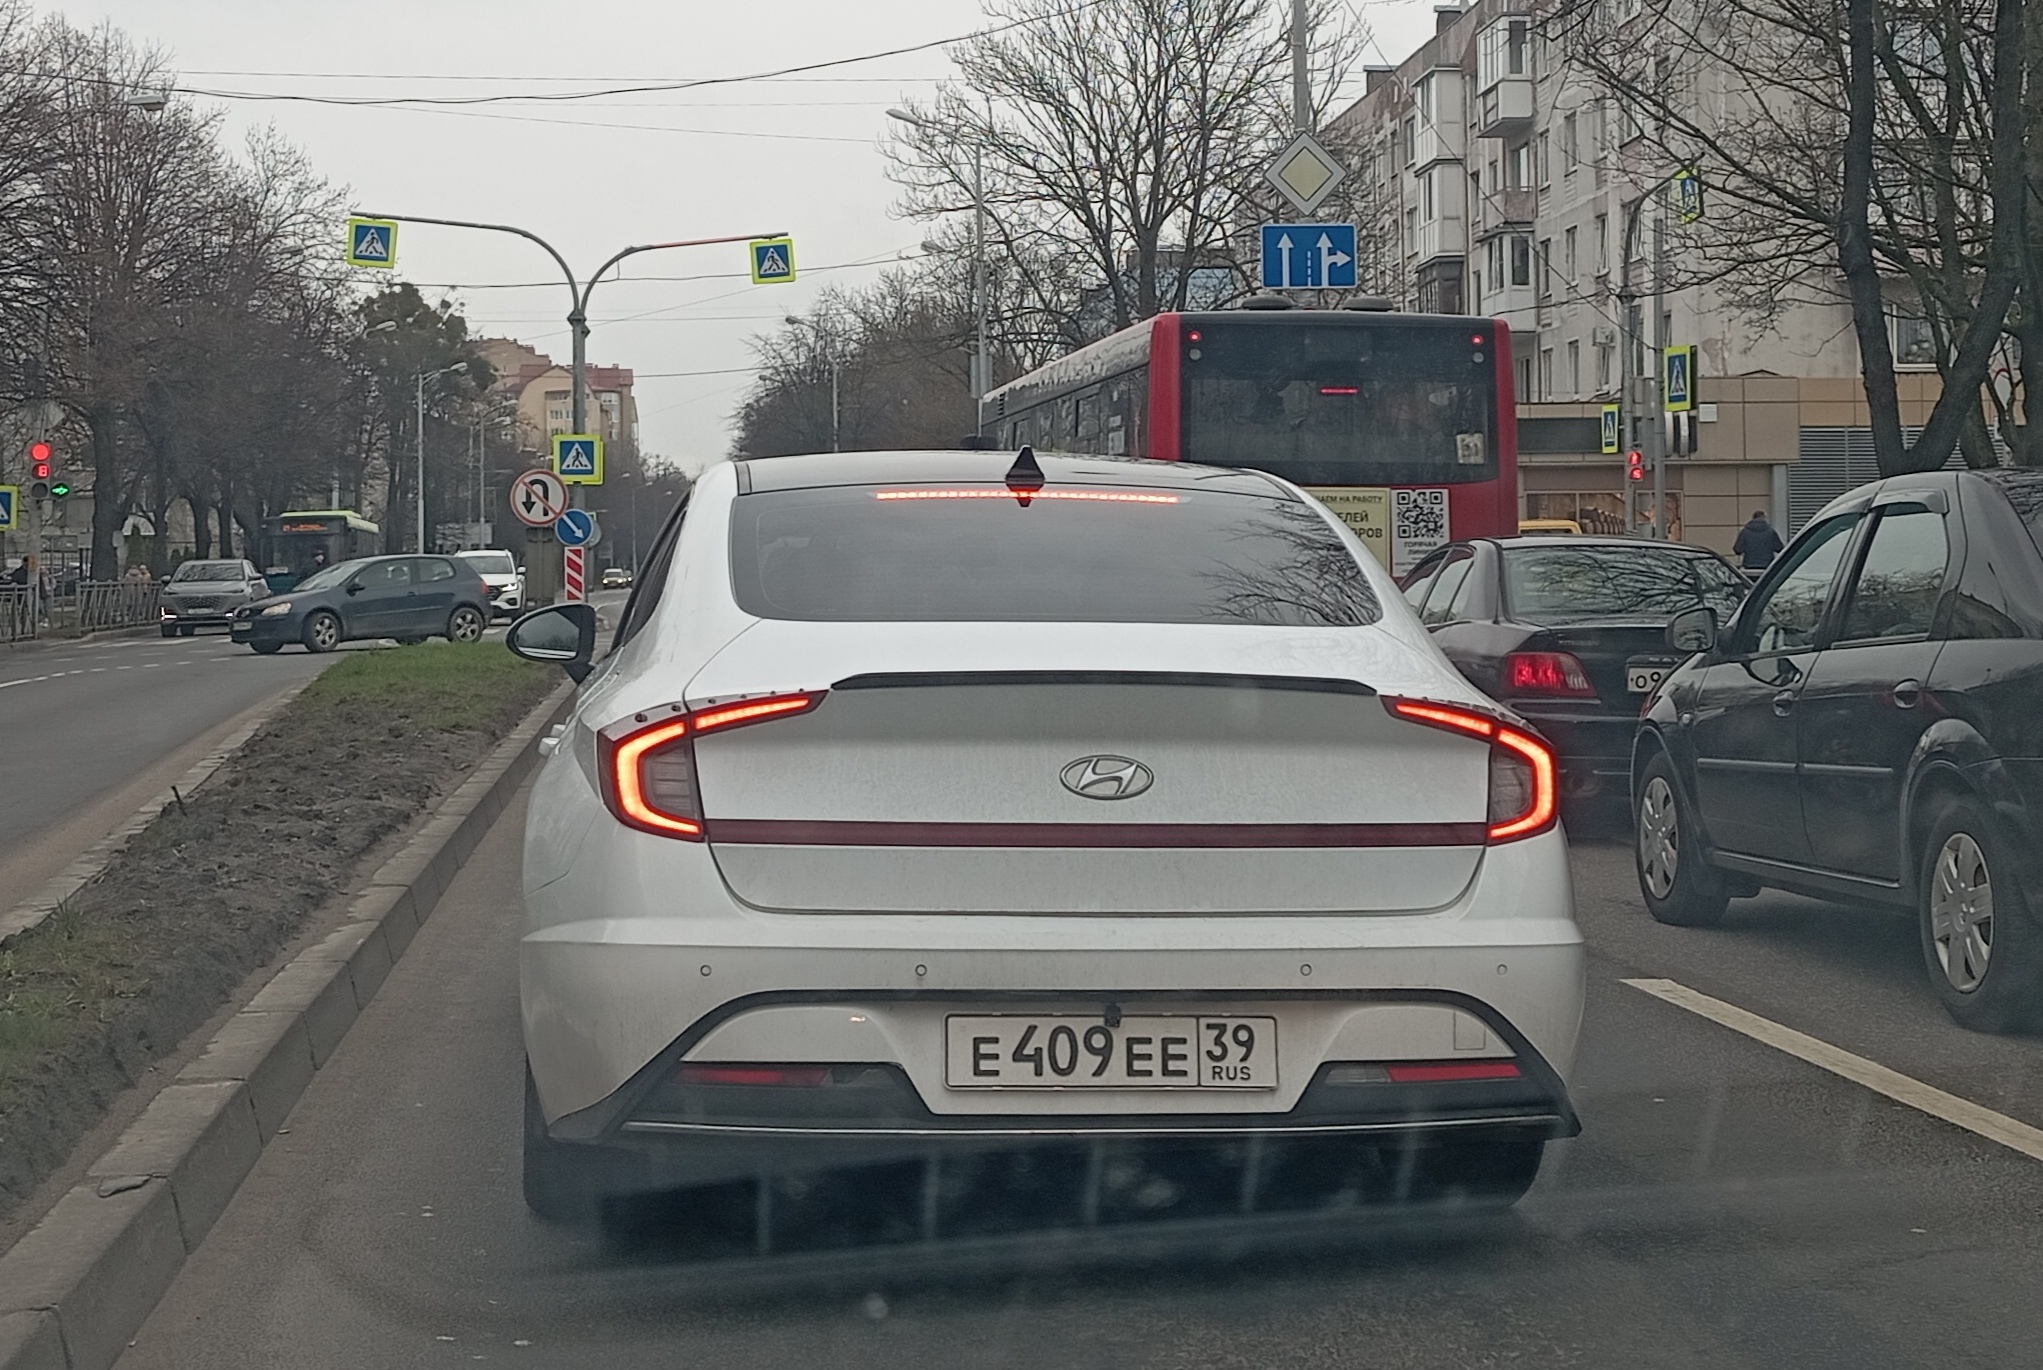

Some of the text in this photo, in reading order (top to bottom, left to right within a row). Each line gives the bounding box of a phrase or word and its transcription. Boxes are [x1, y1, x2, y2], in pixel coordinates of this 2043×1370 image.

[1337, 510, 1369, 523] ЕЛЕЙ
[972, 1022, 1256, 1078] Е409ЕЕ 39
[1211, 1065, 1252, 1081] RUS
